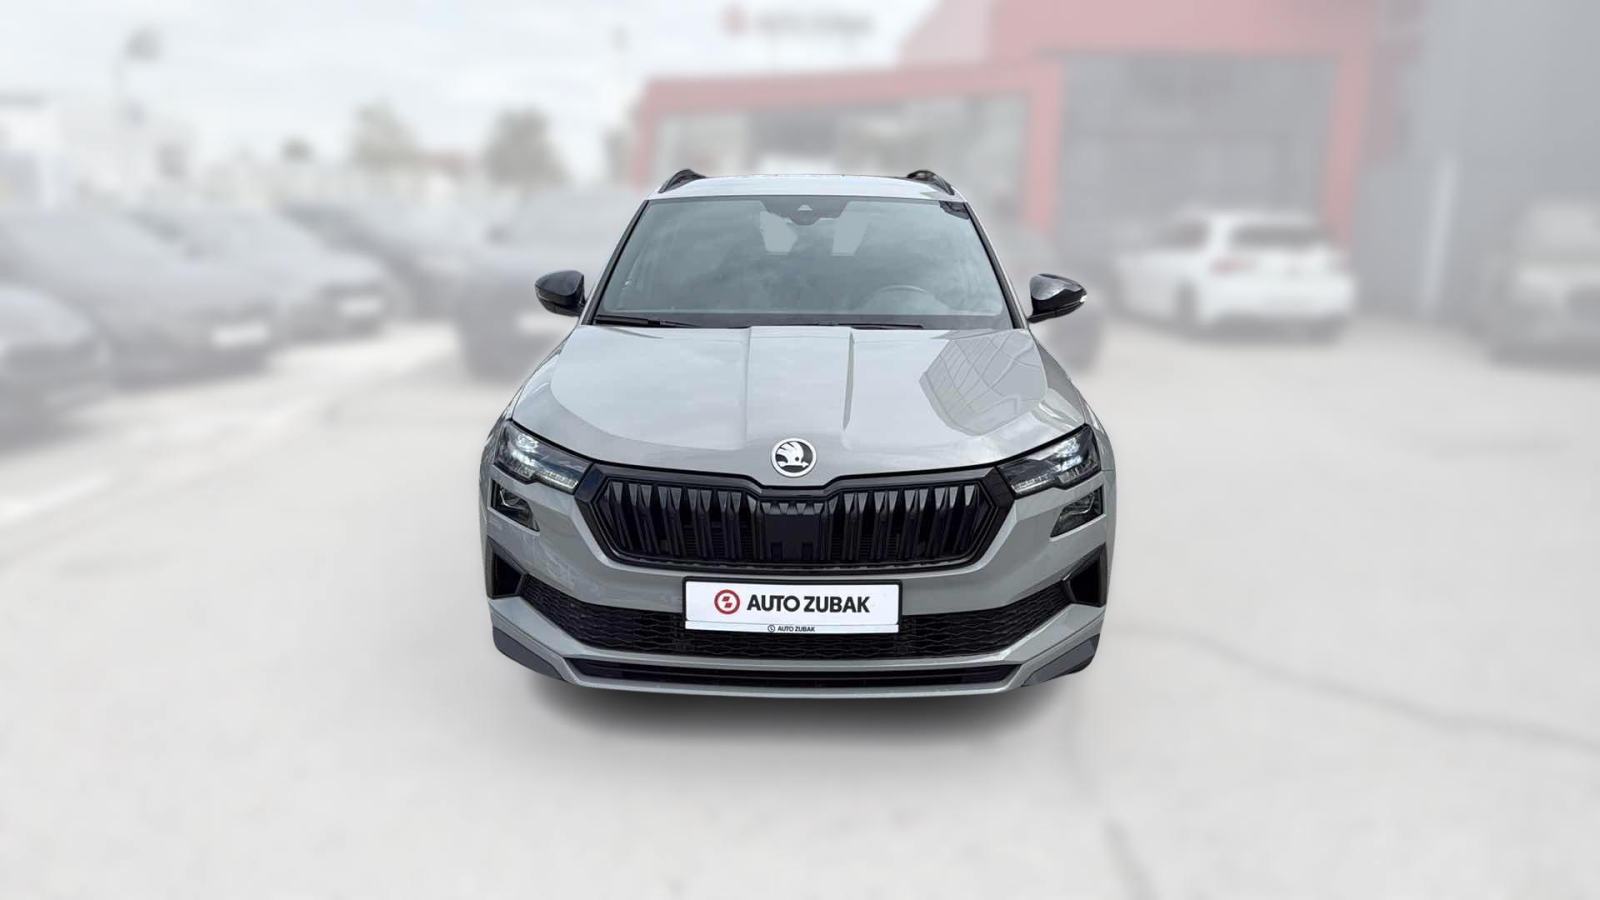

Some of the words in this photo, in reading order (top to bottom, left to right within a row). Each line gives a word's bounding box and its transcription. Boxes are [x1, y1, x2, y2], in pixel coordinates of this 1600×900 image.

[747, 594, 800, 613] AUTO
[803, 596, 870, 613] ZUBAK
[795, 625, 816, 633] ZUBAK
